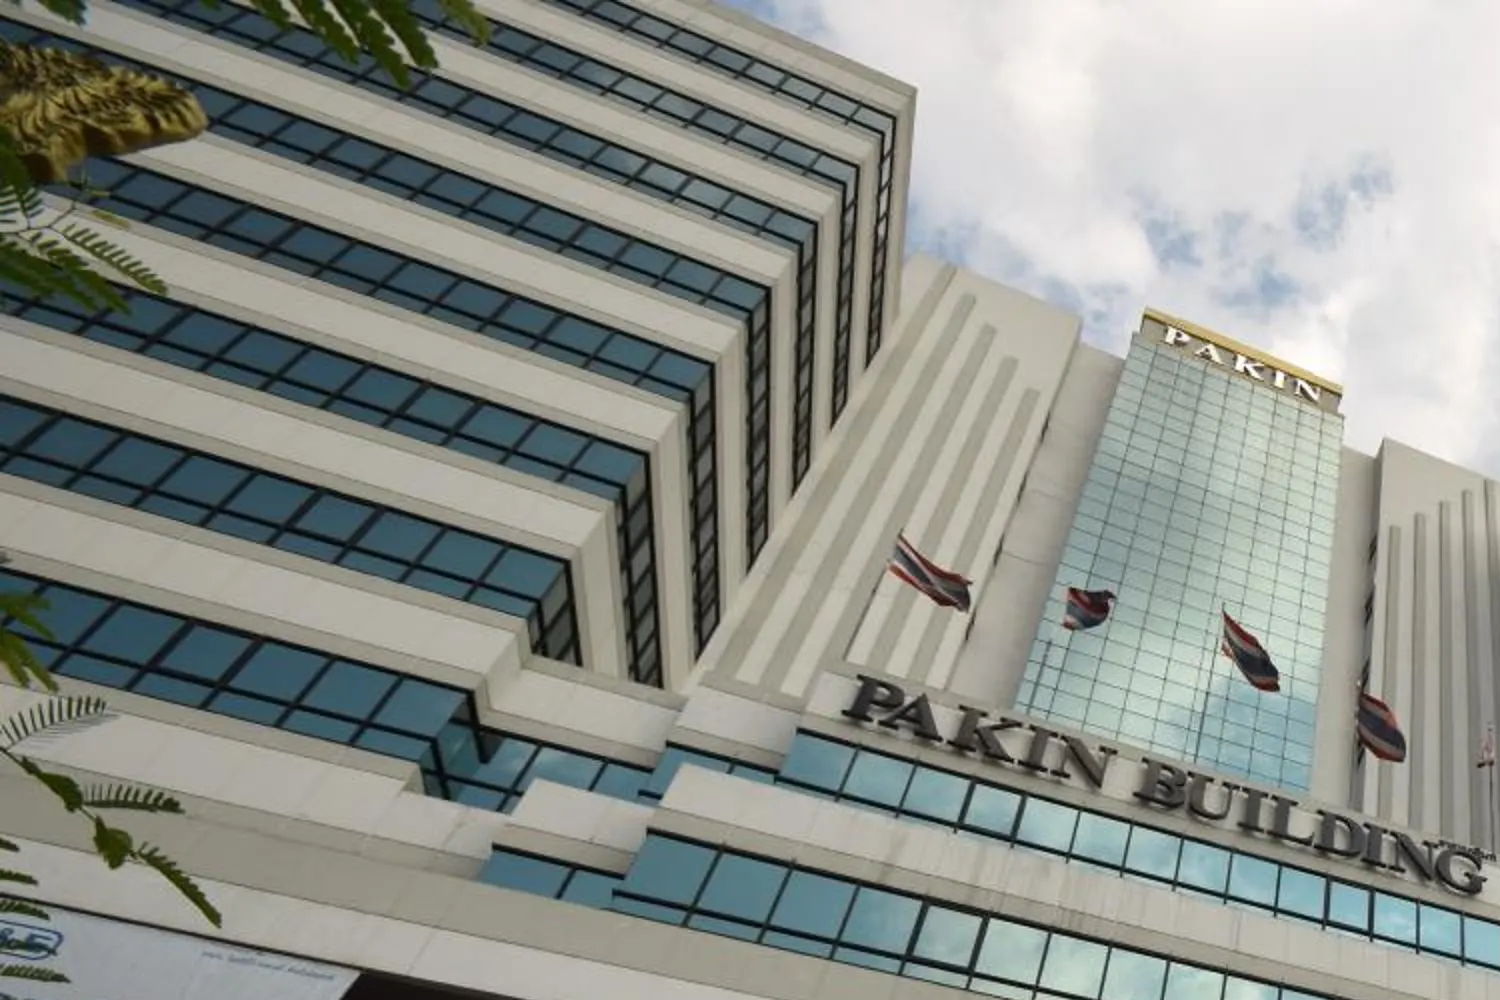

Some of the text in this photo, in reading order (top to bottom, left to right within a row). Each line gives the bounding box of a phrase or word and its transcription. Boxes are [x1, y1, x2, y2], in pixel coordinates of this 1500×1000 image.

[1164, 325, 1322, 404] PAKIN
[841, 673, 1488, 896] PAKIN BUILDING
